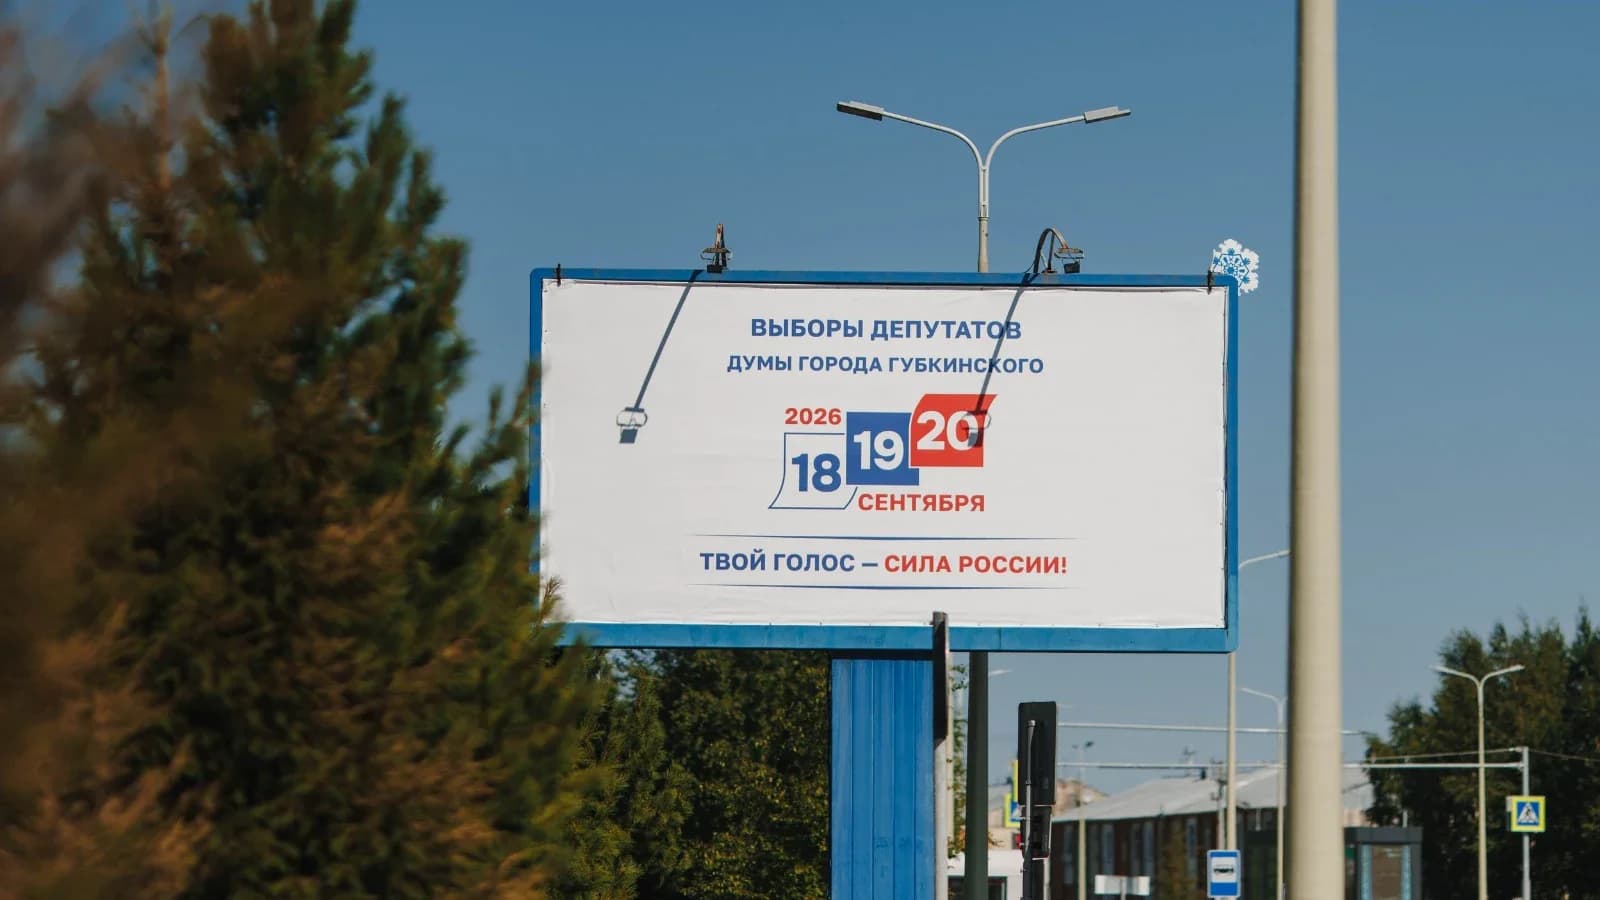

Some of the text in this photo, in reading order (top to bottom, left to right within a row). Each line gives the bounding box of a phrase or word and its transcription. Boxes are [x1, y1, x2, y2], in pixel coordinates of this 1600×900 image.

[751, 319, 1022, 341] ВЫБОРЫ ДЕПУТАТОВ
[726, 355, 1044, 374] ДУМЫ ГОРОДА ГУБКИНСКОГО
[784, 407, 842, 425] 2026
[791, 410, 979, 492] 18 19 20
[857, 493, 986, 512] СЕНТЯБРЯ
[700, 548, 766, 572] ТВОЙ
[773, 553, 855, 572] ГОЛОС
[883, 555, 952, 573] СИЛА
[958, 555, 1068, 574] РОССИИ!
